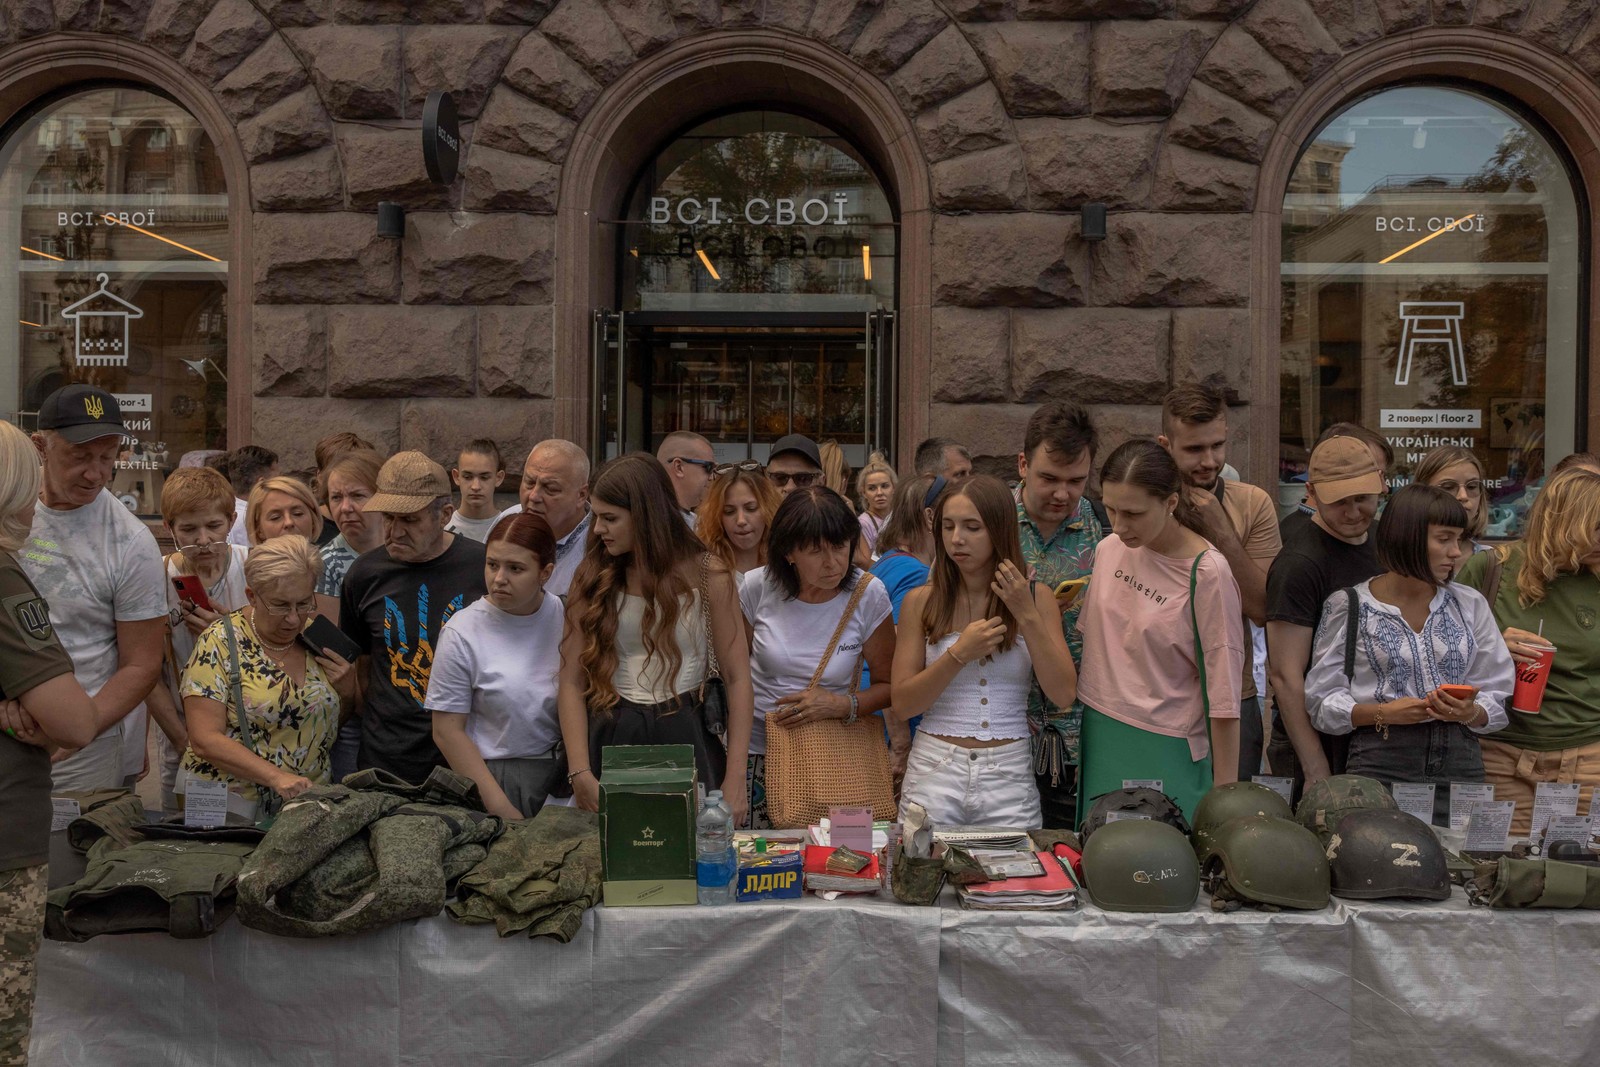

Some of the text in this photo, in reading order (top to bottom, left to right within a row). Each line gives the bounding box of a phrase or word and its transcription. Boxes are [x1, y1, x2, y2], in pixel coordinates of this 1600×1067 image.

[651, 192, 848, 225] ВСІ. СВОЇ
[58, 209, 155, 226] ВСІ. СВОЇ
[1375, 214, 1485, 232] ВСІ. СВОЇ
[116, 398, 146, 407] loor -1
[1388, 414, 1394, 423] 2
[1397, 415, 1433, 424] поверх
[1441, 414, 1465, 423] floor
[1467, 414, 1474, 423] 2
[1386, 434, 1474, 448] УКРАЇНСЬКІ
[114, 460, 159, 470] TEXTILE
[1391, 842, 1421, 867] Z
[743, 871, 797, 893] ЛДПР
